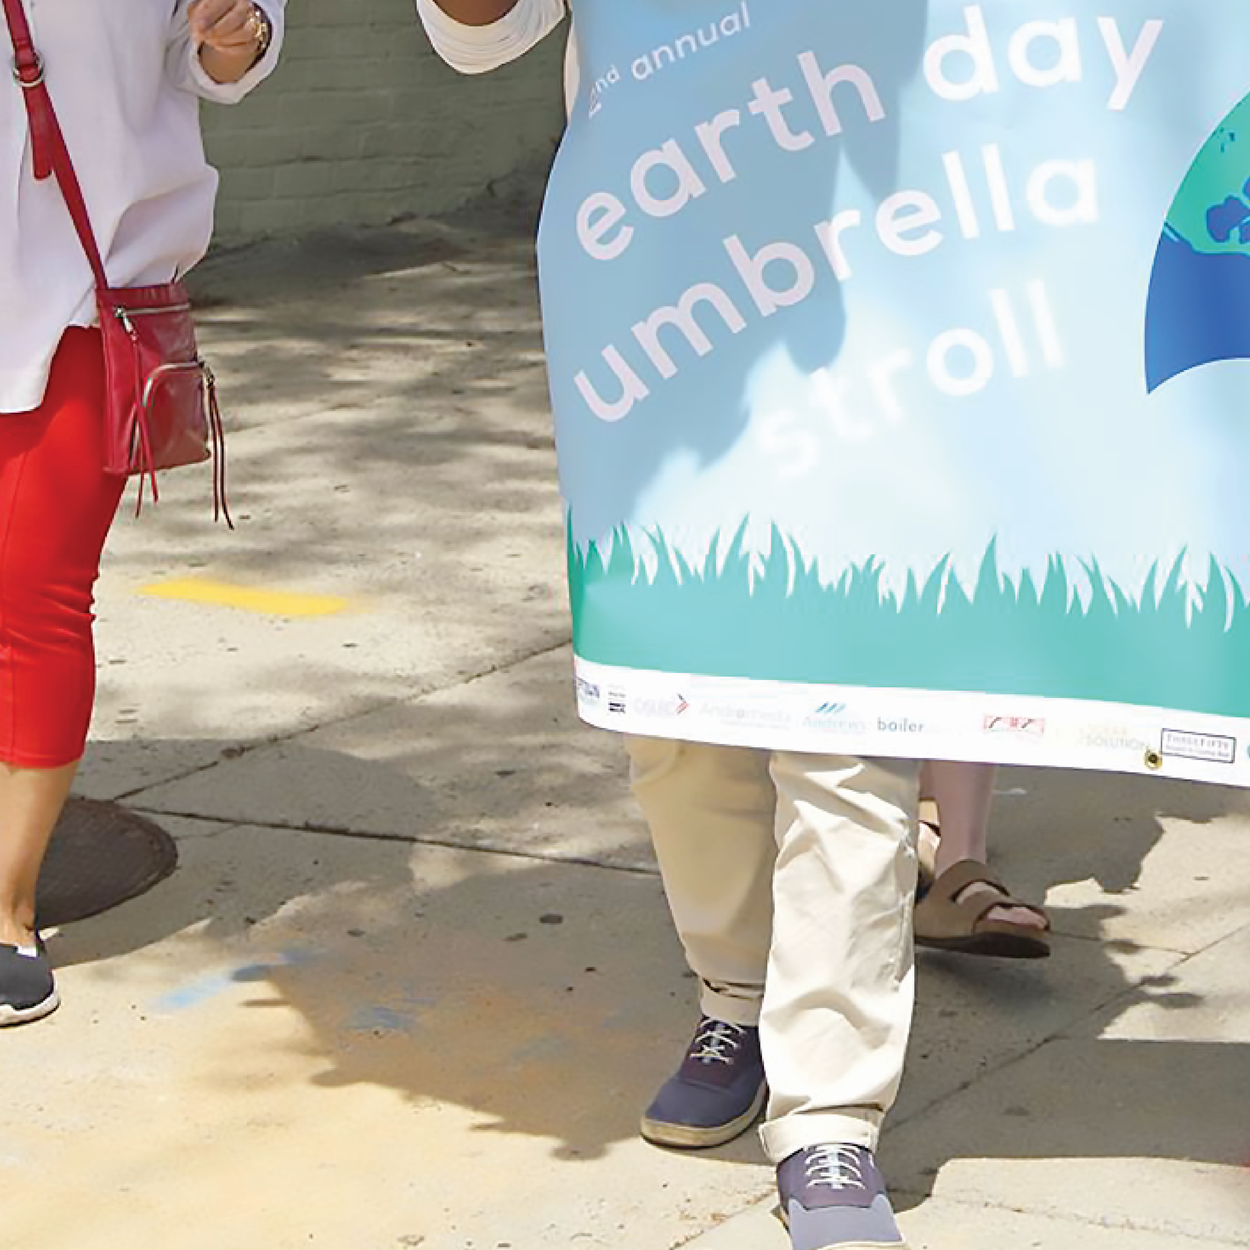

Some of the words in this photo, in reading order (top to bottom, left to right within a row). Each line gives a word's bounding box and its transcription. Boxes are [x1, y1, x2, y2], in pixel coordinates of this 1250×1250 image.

[575, 51, 886, 262] earth
[922, 4, 1164, 111] day
[631, 0, 751, 81] annual
[573, 144, 1100, 424] umbrella
[757, 278, 1066, 476] stroll
[876, 716, 925, 733] boiler
